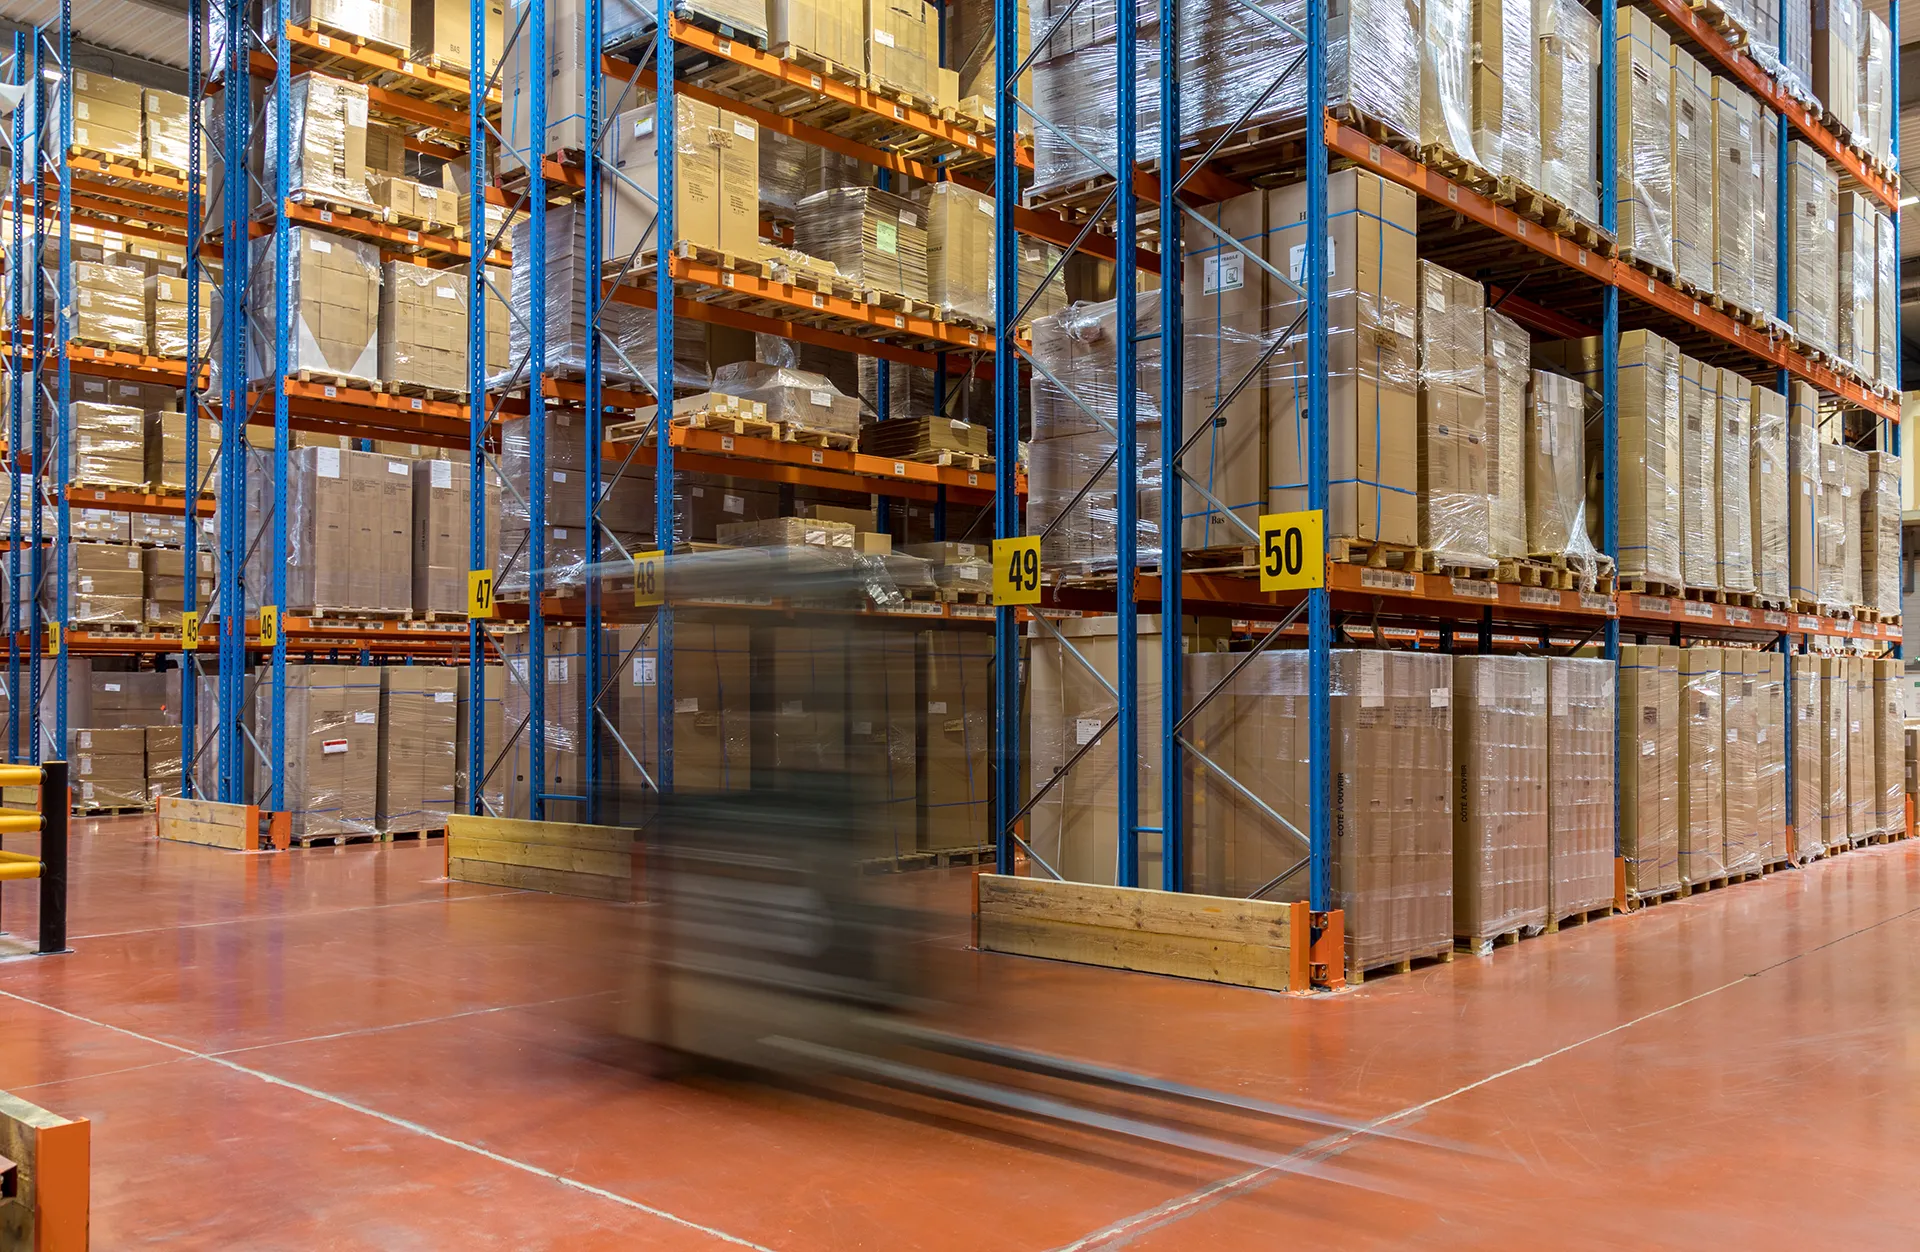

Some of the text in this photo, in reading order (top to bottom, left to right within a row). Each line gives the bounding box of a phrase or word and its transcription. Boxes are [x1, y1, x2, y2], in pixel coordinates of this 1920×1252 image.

[449, 43, 461, 54] BAS
[1220, 254, 1238, 263] FRAGILE
[1211, 515, 1226, 525] Bas
[1264, 527, 1303, 578] 50
[636, 560, 656, 596] 48
[1008, 548, 1038, 592] 49
[476, 578, 491, 610] 47
[50, 627, 57, 649] 44
[187, 618, 197, 642] 45
[261, 614, 272, 640] 46
